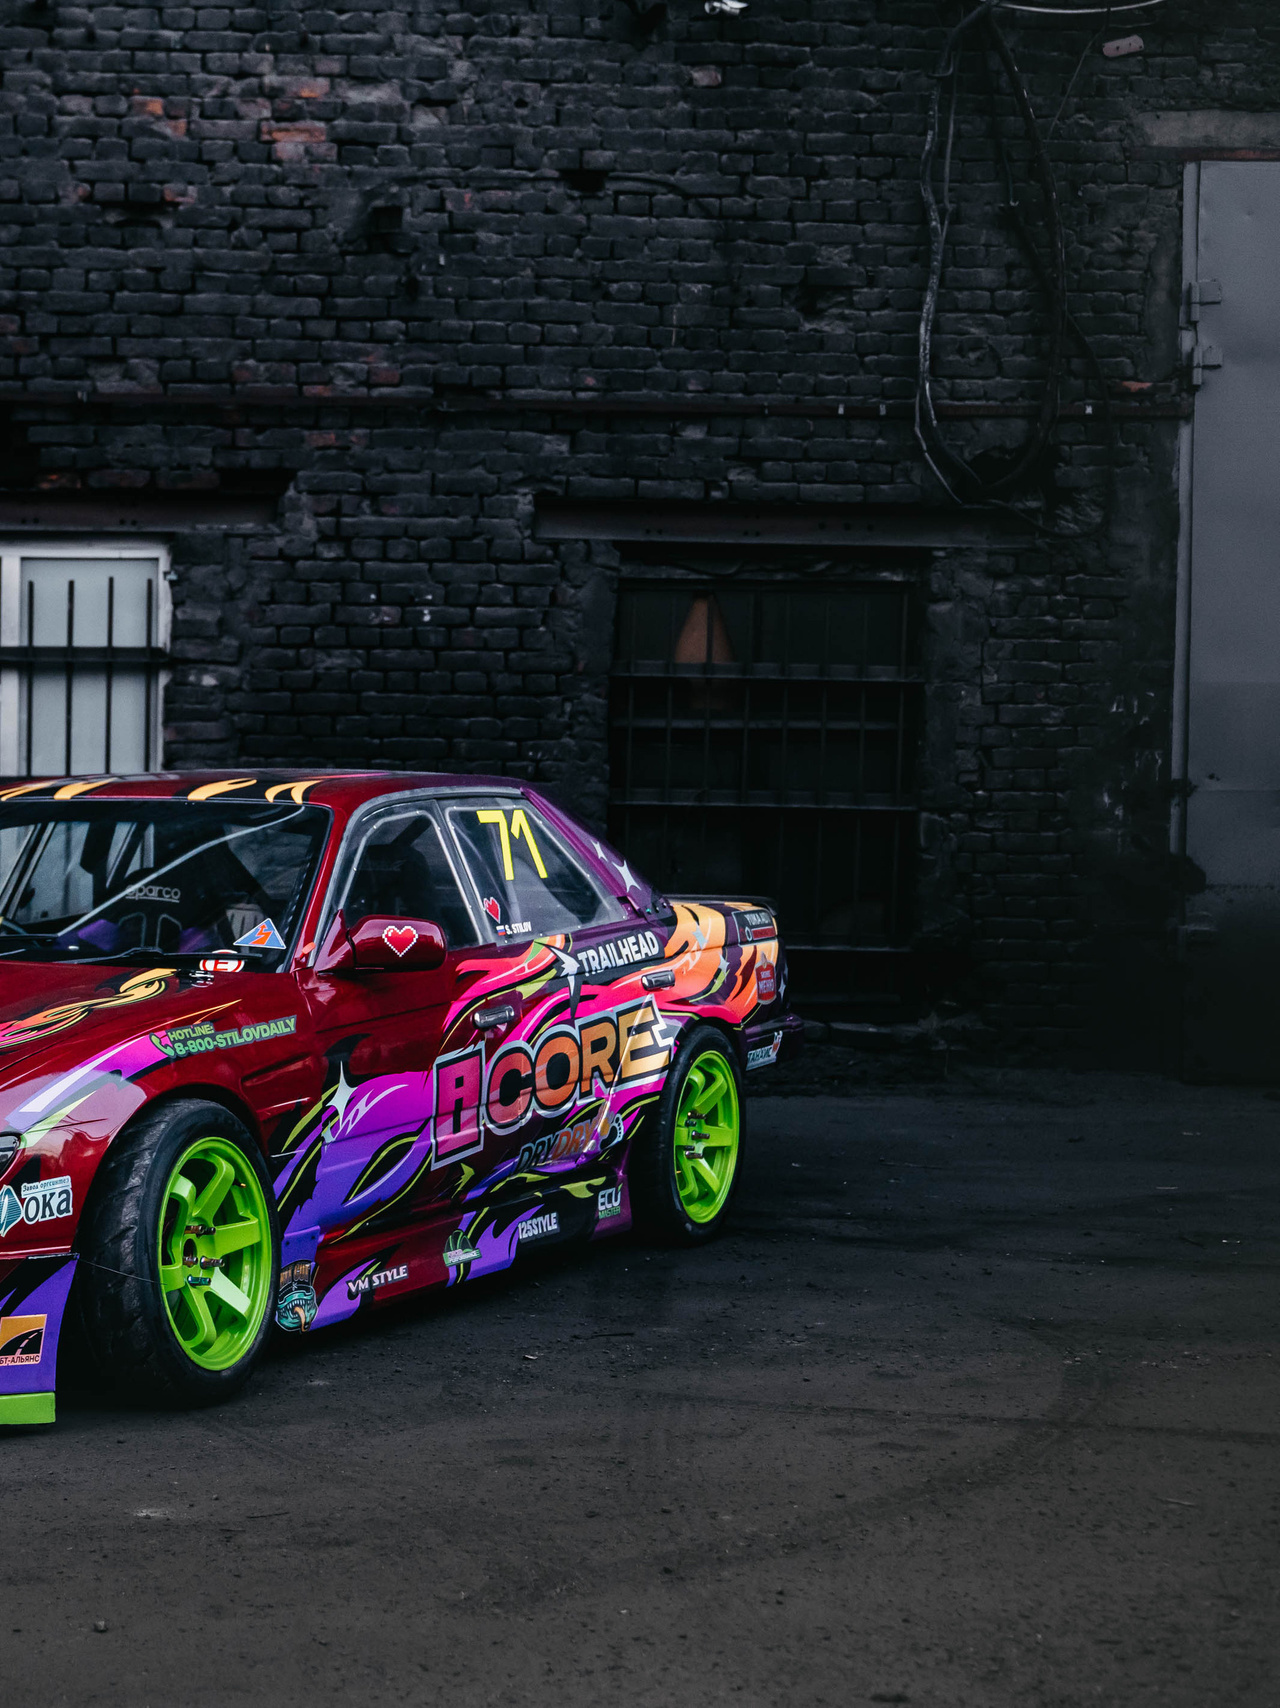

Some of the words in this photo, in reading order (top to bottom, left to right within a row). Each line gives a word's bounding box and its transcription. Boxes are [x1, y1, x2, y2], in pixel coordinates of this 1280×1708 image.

[477, 810, 548, 880] 71
[505, 924, 513, 935] S.
[511, 921, 532, 934] STILOV
[577, 931, 660, 976] TRAILHEAD
[168, 1024, 215, 1042] HOTLINE:
[174, 1018, 296, 1055] 8-800-STILOVDAILY
[598, 1187, 622, 1211] ECU
[518, 1212, 558, 1239] 125STYLE
[348, 1279, 369, 1293] VM
[372, 1265, 408, 1286] STYLE
